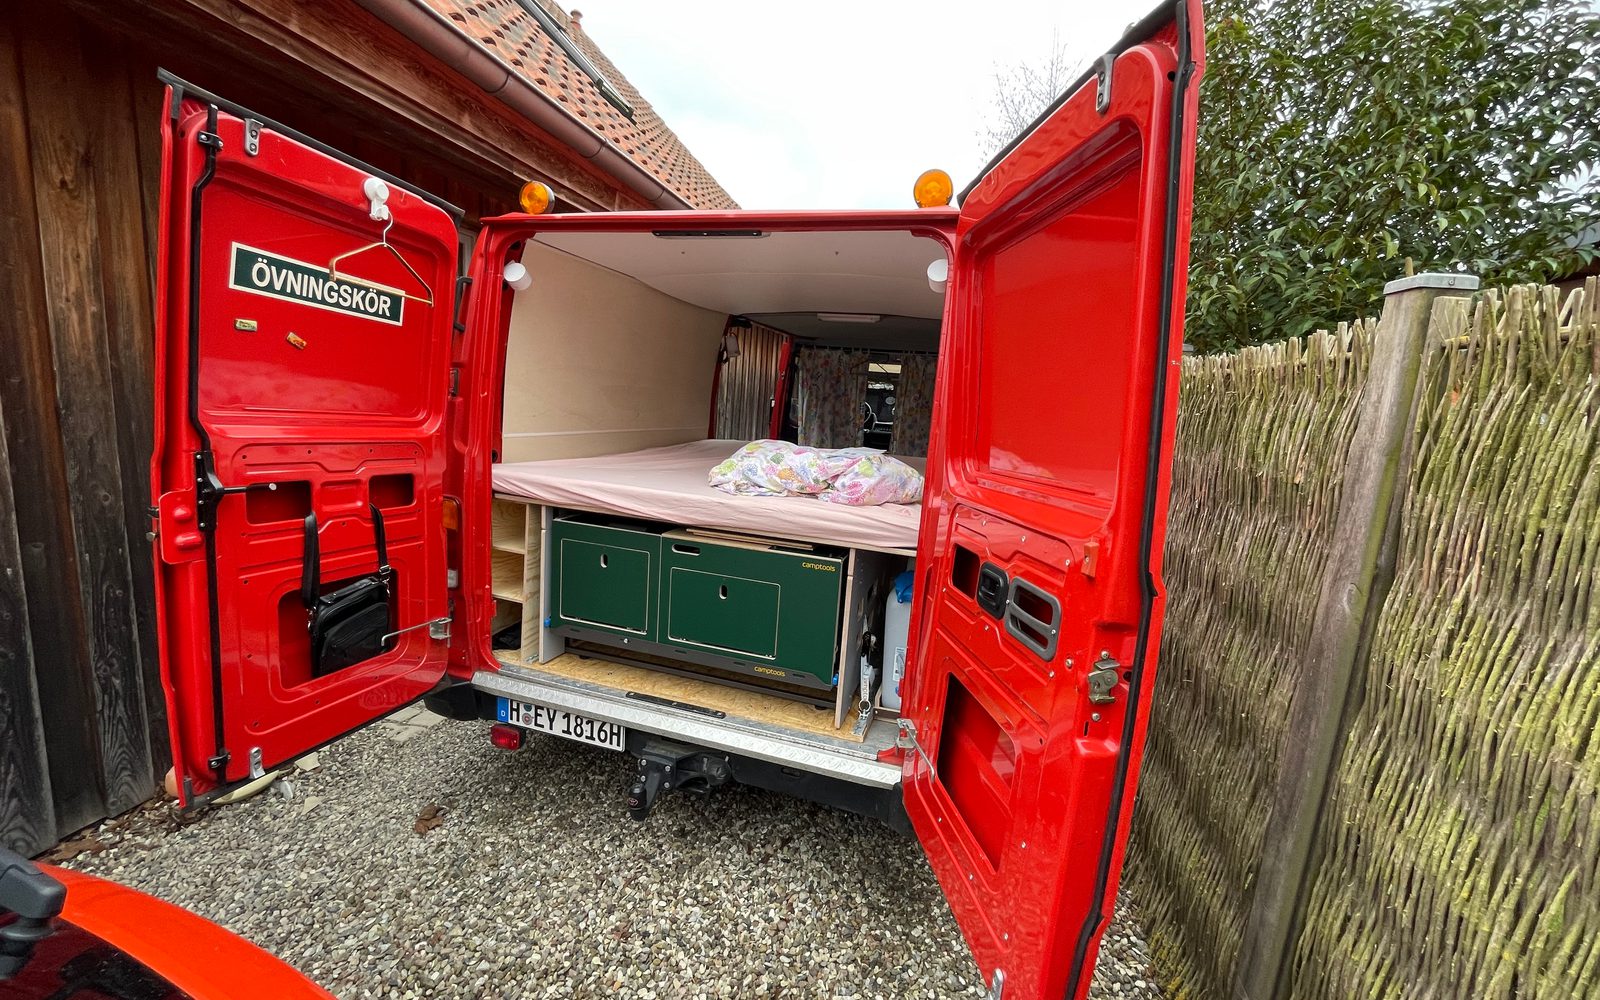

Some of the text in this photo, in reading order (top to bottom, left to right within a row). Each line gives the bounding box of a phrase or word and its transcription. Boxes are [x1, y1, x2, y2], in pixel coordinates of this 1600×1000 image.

[251, 257, 391, 317] ÖVNINGSKÖR
[801, 561, 836, 572] camptools
[753, 666, 786, 677] camptools
[510, 699, 621, 748] H EY 1816H
